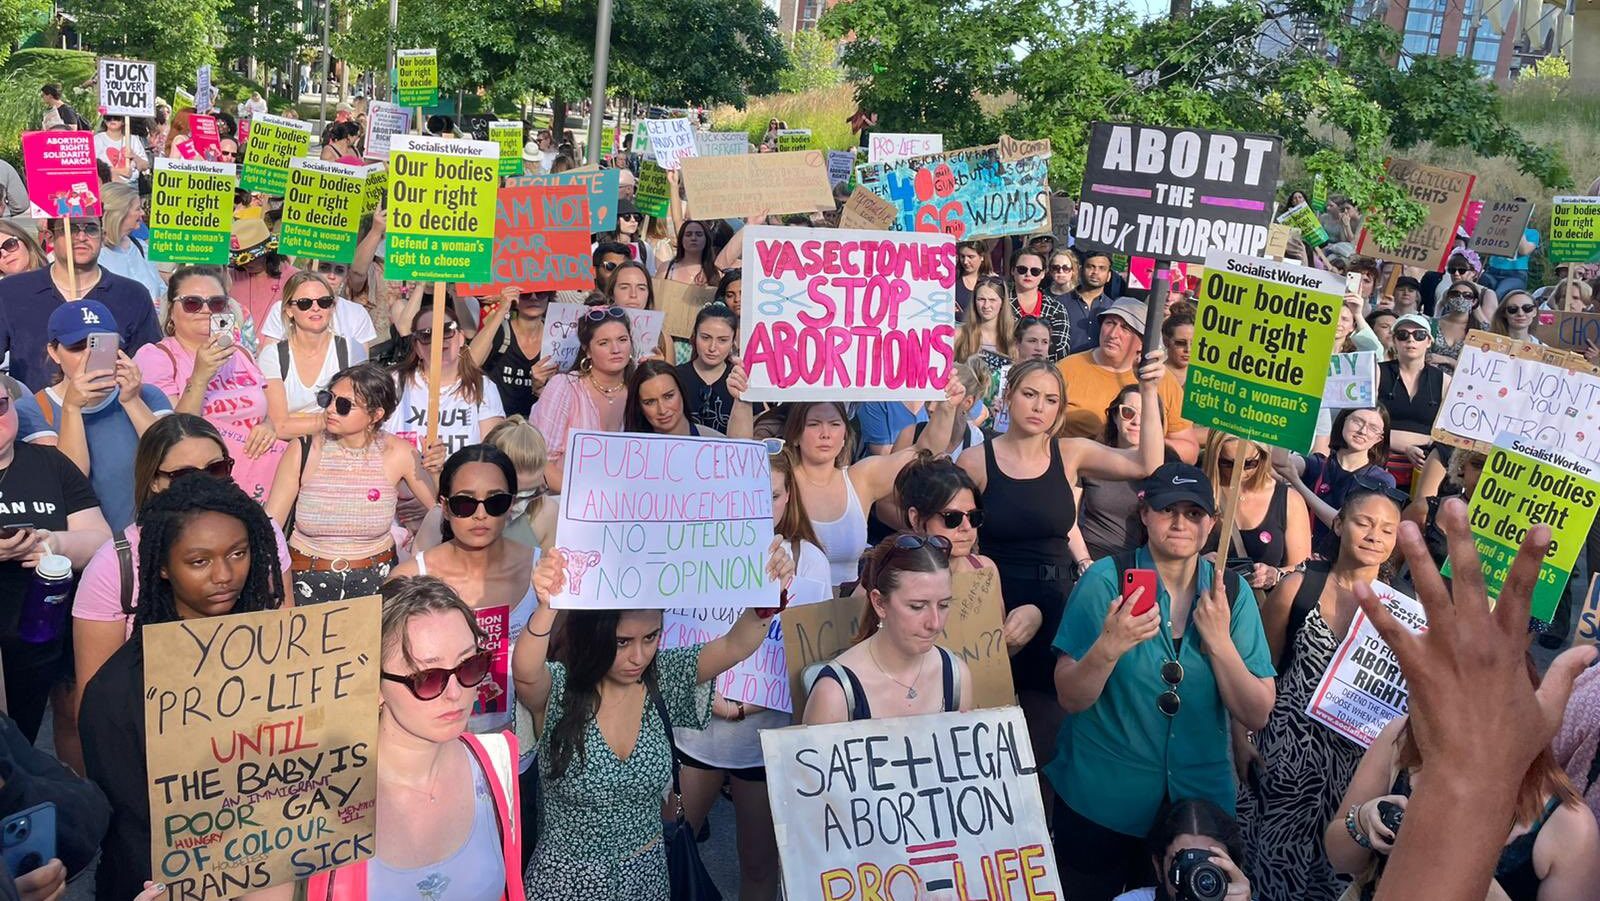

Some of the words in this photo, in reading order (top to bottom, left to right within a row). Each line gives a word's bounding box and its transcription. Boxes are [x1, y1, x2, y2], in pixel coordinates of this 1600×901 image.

[105, 63, 149, 82] FUCK
[105, 81, 122, 91] YOU
[125, 81, 147, 92] VERY
[108, 90, 147, 108] MUCH
[253, 122, 274, 137] Our
[275, 127, 307, 144] bodies
[646, 121, 667, 134] GET
[671, 120, 687, 132] UR
[46, 137, 89, 146] ABORTION
[60, 144, 91, 152] RIGHTS
[251, 136, 269, 150] Our
[273, 140, 297, 157] right
[408, 140, 482, 157] SocialistWorker
[652, 135, 675, 149] HANDS
[675, 133, 692, 147] OFF
[43, 151, 91, 159] SOLIDARITY
[61, 158, 91, 166] MARCH
[249, 151, 259, 163] to
[262, 153, 290, 169] decid
[1102, 125, 1274, 187] ABORT
[168, 162, 223, 174] SocialistWorker
[302, 161, 355, 176] SocialistWorker
[395, 154, 428, 178] Our
[434, 157, 494, 182] bodies
[157, 172, 183, 189] Our
[187, 174, 231, 192] bodies
[291, 170, 315, 187] Our
[320, 174, 361, 195] bodies
[156, 190, 182, 207] Our
[186, 194, 220, 212] right
[289, 188, 314, 205] Our
[316, 193, 349, 210] right
[393, 180, 427, 203] Our
[434, 184, 478, 210] right
[1155, 182, 1196, 209] THE
[287, 206, 301, 221] to
[305, 208, 348, 228] decide
[540, 194, 590, 227] NOT
[1492, 202, 1520, 212] BANS
[1555, 204, 1570, 215] Our
[155, 210, 170, 224] to
[175, 211, 220, 228] decide
[392, 207, 413, 229] to
[419, 208, 478, 233] decide
[1492, 214, 1512, 224] OFF
[1554, 216, 1570, 227] Our
[1572, 216, 1593, 230] right
[153, 230, 182, 240] Defend
[192, 233, 224, 242] woman's
[283, 236, 301, 247] right
[303, 238, 312, 247] to
[313, 240, 340, 251] choose
[284, 225, 312, 236] Defend
[320, 230, 350, 241] woman's
[391, 235, 428, 250] Defend
[431, 240, 437, 250] a
[441, 239, 485, 253] woman's
[1474, 237, 1509, 249] BODIES
[1553, 229, 1567, 239] to
[1569, 229, 1594, 239] decide
[153, 242, 173, 253] right
[175, 243, 184, 251] to
[186, 244, 214, 253] choose
[493, 233, 553, 258] YOUR
[390, 252, 416, 268] right
[419, 254, 431, 266] to
[433, 255, 471, 267] choose
[493, 253, 593, 283] CUBATOR
[754, 239, 957, 290] VASECTOMIES
[1226, 258, 1323, 290] SocialistWorker
[797, 275, 911, 330] STOP
[1207, 273, 1248, 306] Our
[1253, 283, 1334, 326] bodies
[82, 307, 100, 325] LA
[1202, 304, 1243, 338] Our
[1248, 318, 1308, 355] right
[743, 321, 956, 390] ABORTIONS
[1197, 336, 1220, 365] to
[1227, 345, 1304, 387] decide
[1470, 352, 1509, 383] WE
[1193, 369, 1237, 396] Defend
[1239, 386, 1247, 400] a
[1252, 388, 1309, 414] woman's
[1516, 365, 1600, 407] WON'T
[1190, 389, 1220, 410] right
[1224, 398, 1237, 415] to
[1240, 404, 1289, 428] choose
[1528, 396, 1561, 416] YOU
[579, 436, 685, 482] PUBLIC
[694, 442, 771, 481] CERVIX
[1512, 440, 1593, 476] SocialistWorker
[1491, 450, 1527, 481] Our
[1527, 464, 1598, 509] bodies
[32, 501, 56, 515] UP
[1480, 478, 1516, 508] Our
[1516, 494, 1570, 531] right
[602, 523, 646, 554] NO
[666, 520, 757, 551] UTERUS
[1469, 504, 1490, 530] to
[1493, 514, 1559, 558] dece
[596, 566, 642, 601] NO
[658, 552, 764, 597] OPINION
[1362, 635, 1379, 651] TO
[740, 673, 757, 703] TO
[763, 677, 792, 711] YOU
[1341, 687, 1368, 708] DEFEND
[1368, 699, 1382, 715] THE
[1325, 691, 1352, 712] CHOOSE
[1351, 705, 1372, 723] WHEN
[1371, 715, 1387, 732] AND
[1335, 710, 1346, 723] TO
[1345, 714, 1363, 731] HAVE
[210, 715, 319, 764] UNTIL
[154, 768, 226, 804] THE
[236, 752, 325, 796] BABY
[328, 742, 369, 774] IS
[221, 797, 241, 811] AN
[246, 774, 333, 805] IMMIGRANT
[164, 803, 264, 848] POOR
[281, 777, 362, 821] GAY
[824, 781, 1015, 852] ABORTION
[174, 831, 225, 850] HUNGRY
[161, 844, 211, 880] OF
[224, 826, 335, 863] COLOUR
[165, 861, 271, 901] TRANS
[290, 832, 374, 879] SICK
